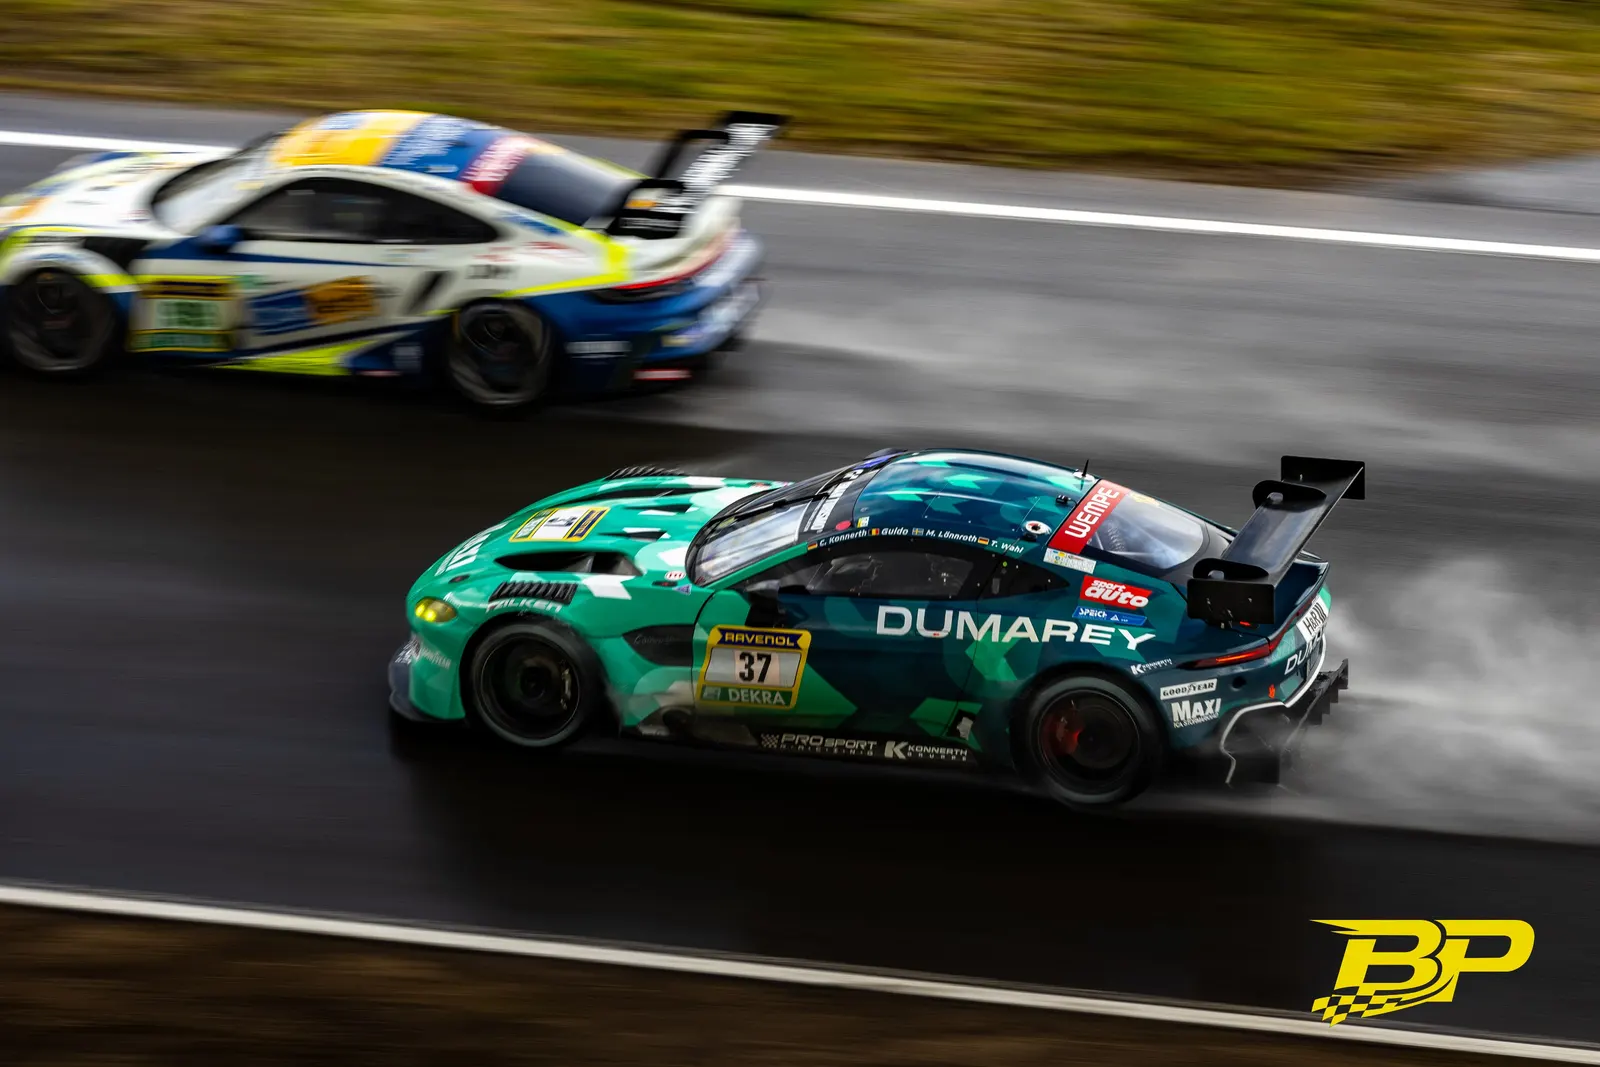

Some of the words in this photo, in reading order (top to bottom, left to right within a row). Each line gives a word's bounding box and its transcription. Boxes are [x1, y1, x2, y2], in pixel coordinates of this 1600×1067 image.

[1064, 486, 1120, 538] WEMPE
[829, 529, 867, 545] Konnerth
[881, 526, 909, 536] Guido
[925, 529, 936, 538] M.
[938, 530, 978, 543] Lönnroth
[991, 540, 998, 548] T.
[1001, 542, 1025, 554] Wahl
[1091, 580, 1127, 593] sport
[1084, 586, 1150, 608] auto
[876, 605, 1157, 651] DUMAREY
[725, 631, 795, 647] RAVENOL
[738, 651, 772, 684] 37
[728, 688, 786, 706] DEKRA
[1162, 682, 1215, 697] GOODYEAR
[1171, 698, 1222, 722] MAXI
